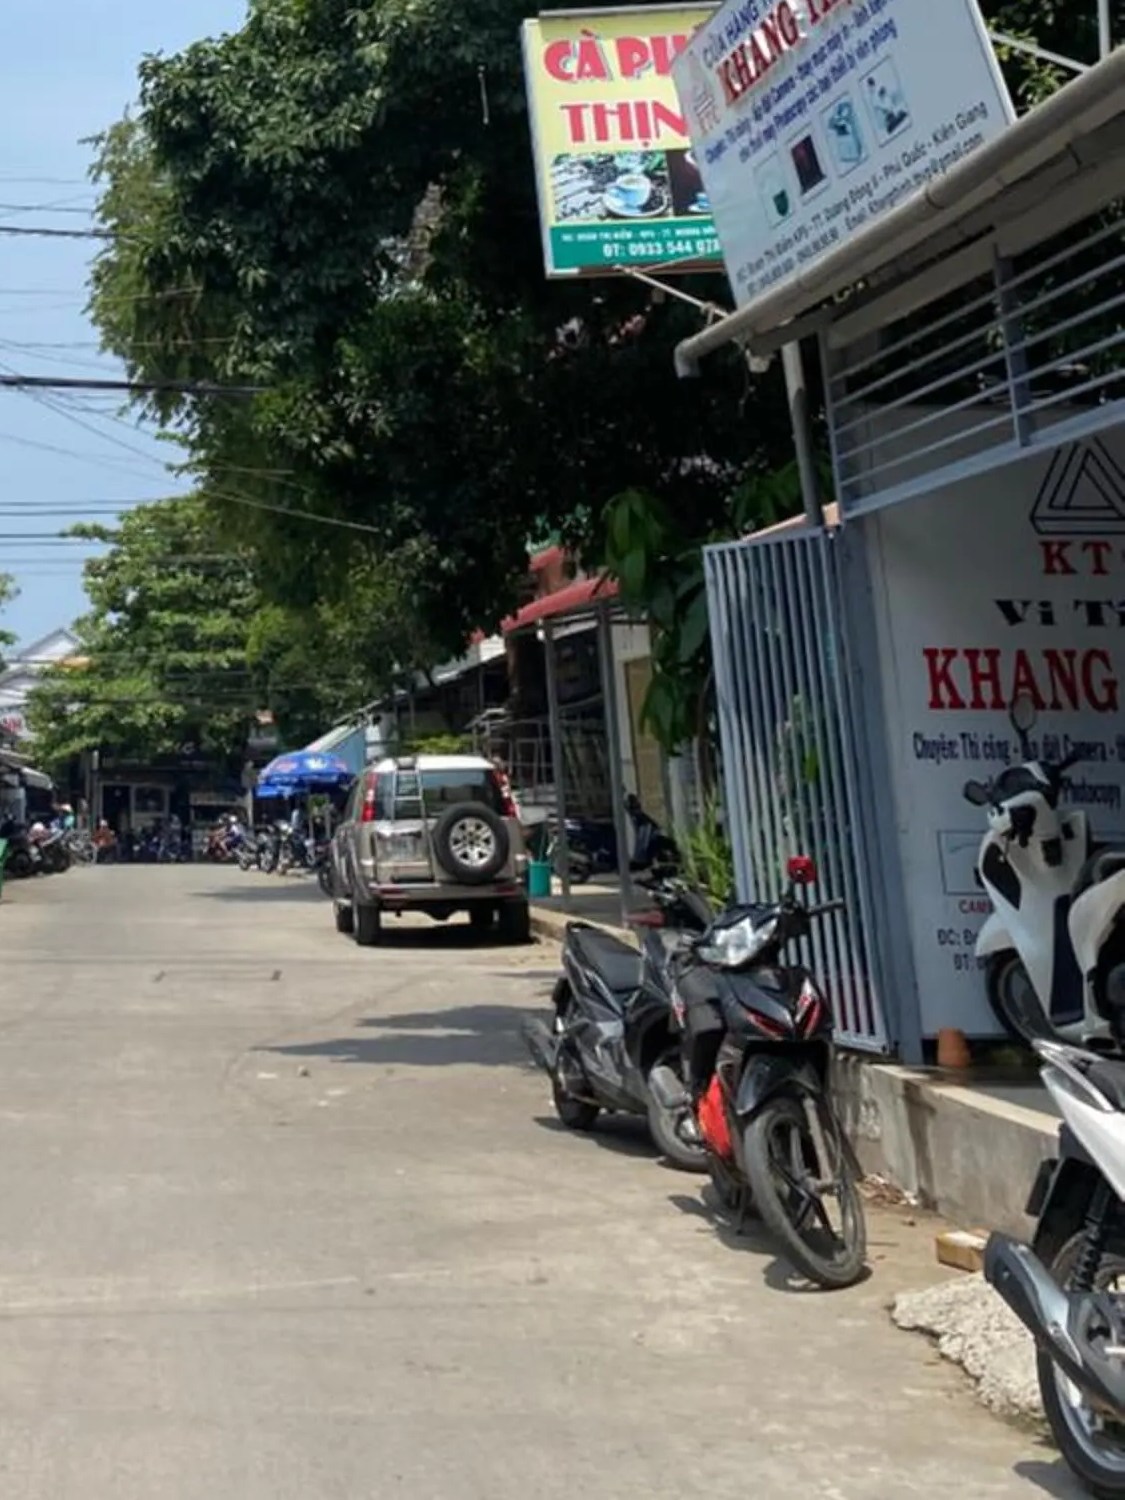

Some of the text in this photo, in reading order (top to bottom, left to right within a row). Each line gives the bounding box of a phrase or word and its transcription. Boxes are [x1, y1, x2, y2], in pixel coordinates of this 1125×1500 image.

[543, 29, 693, 81] CÀ PH
[561, 100, 689, 148] THỊN
[1039, 541, 1125, 575] KT
[923, 647, 1119, 712] KHANG
